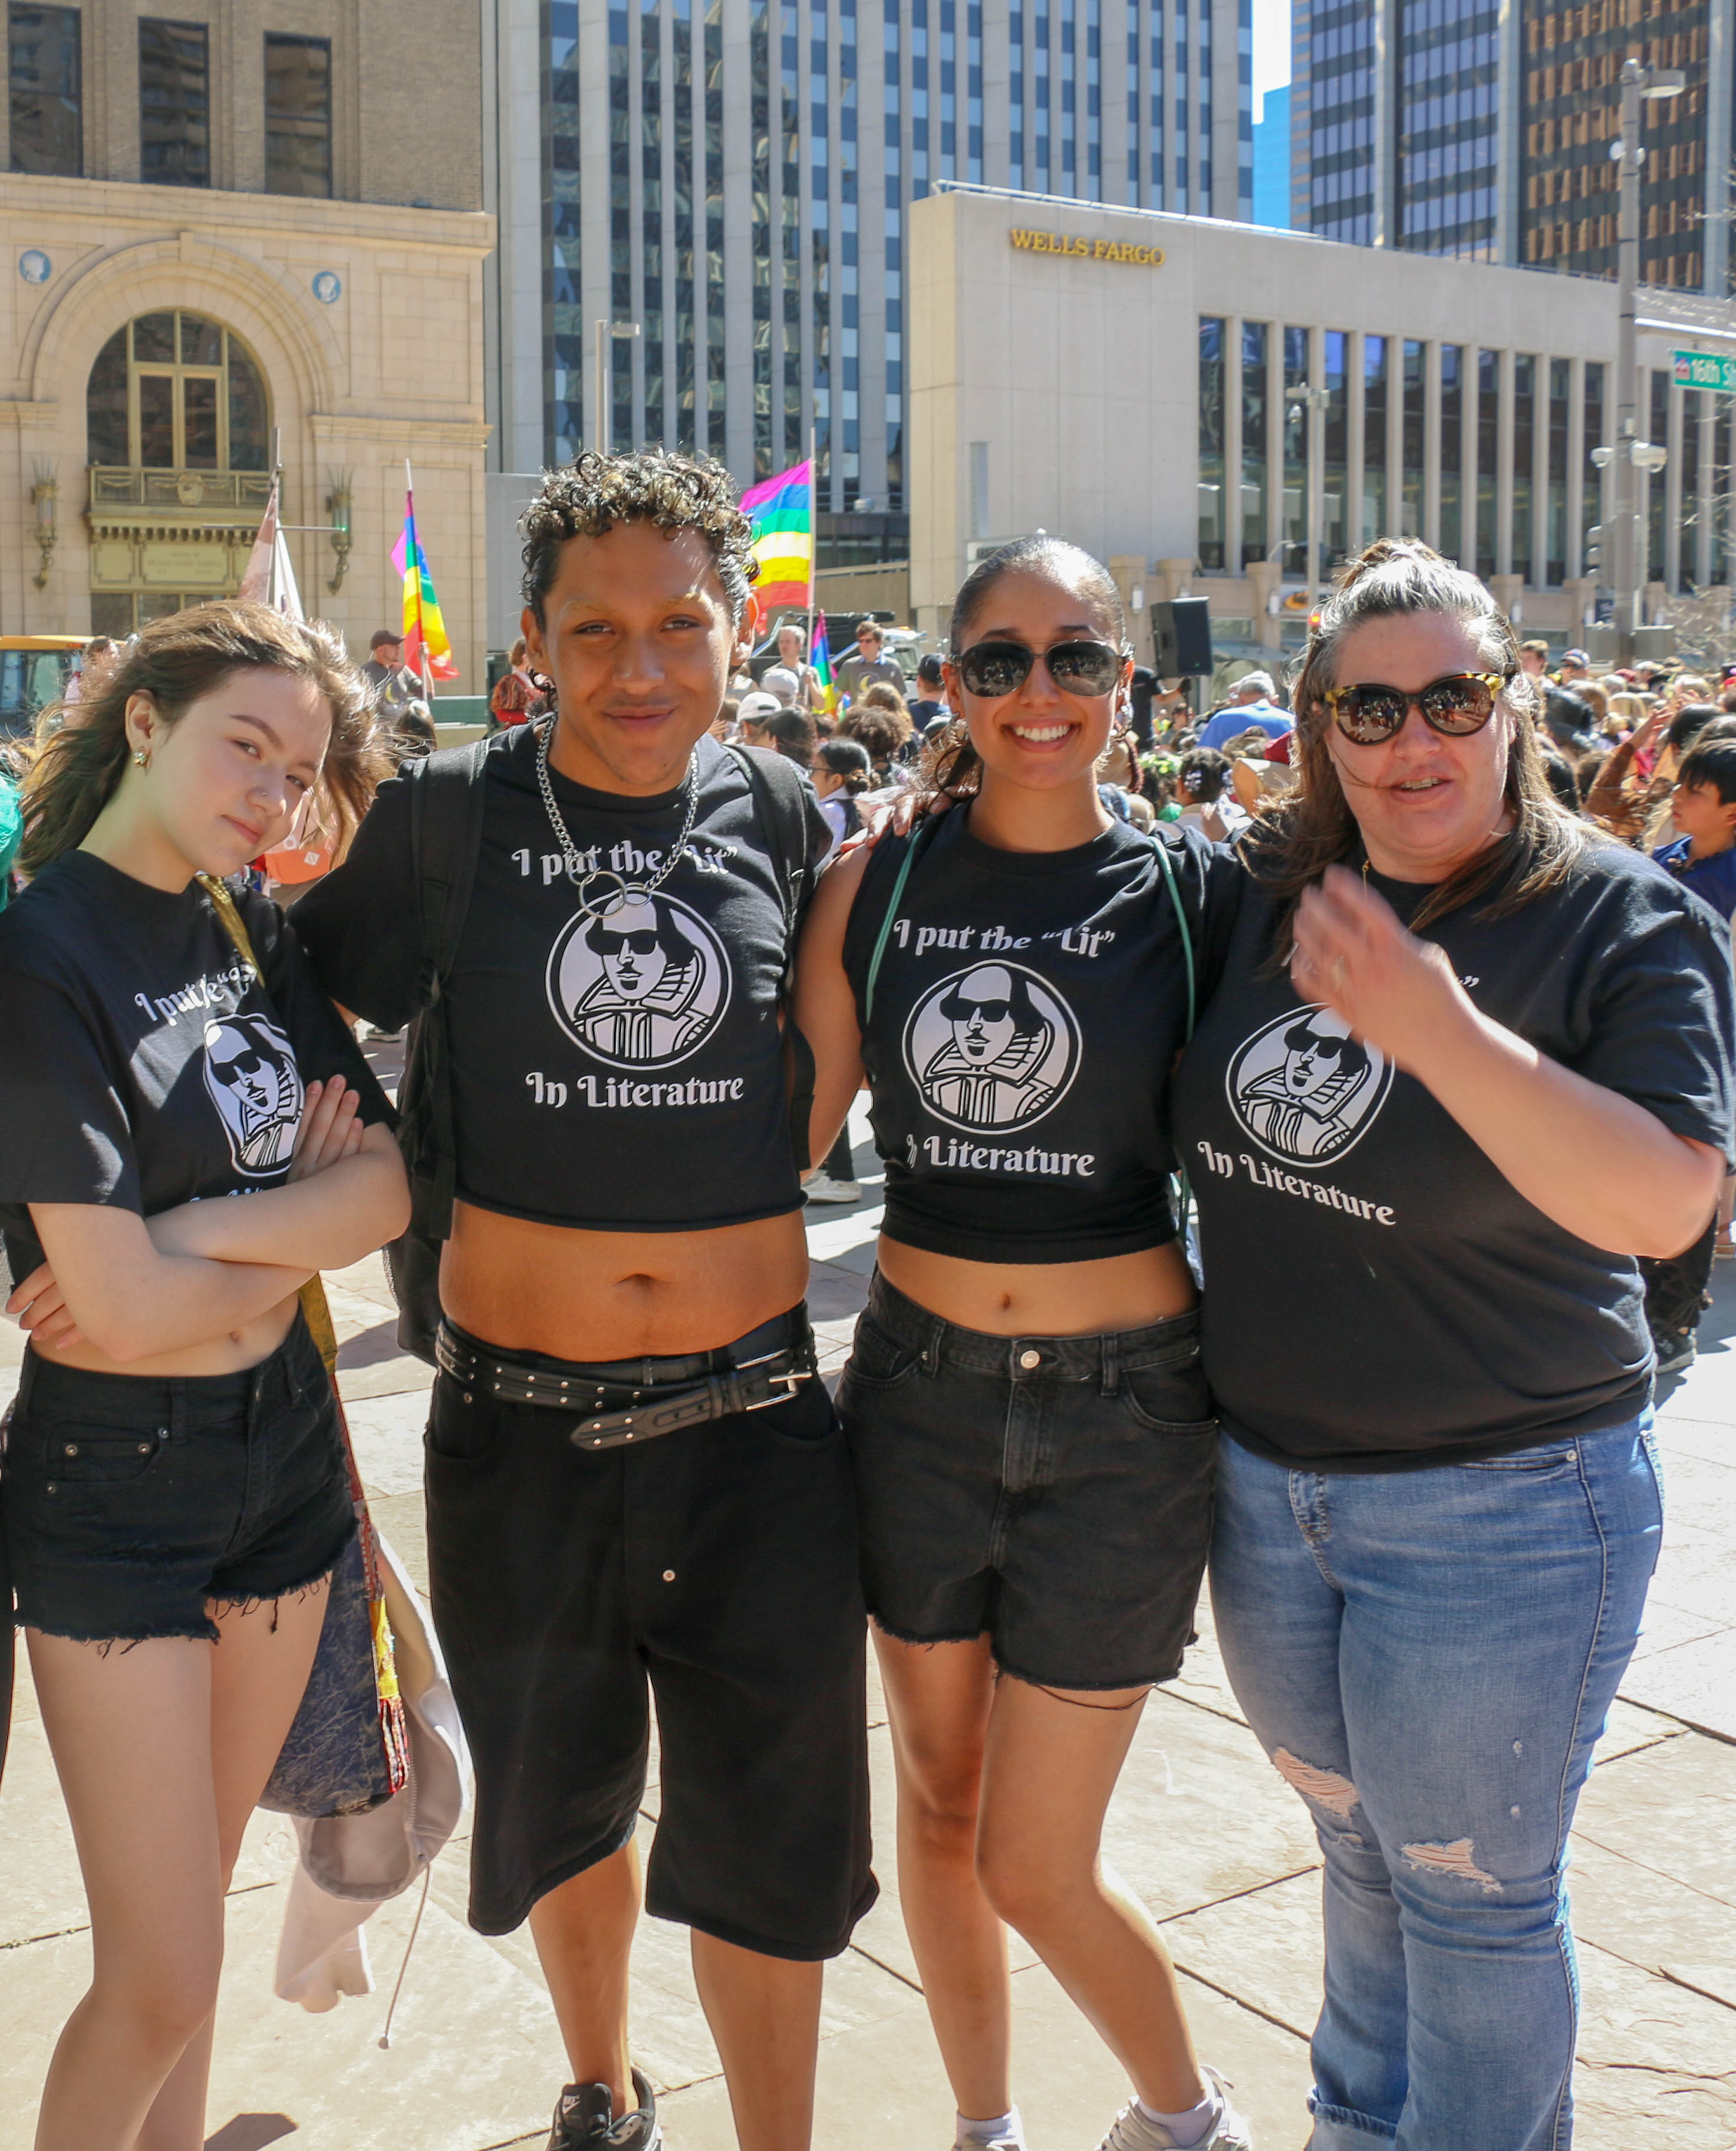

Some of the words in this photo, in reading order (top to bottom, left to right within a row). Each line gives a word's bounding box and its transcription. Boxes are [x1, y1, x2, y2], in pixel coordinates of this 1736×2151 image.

[1011, 228, 1089, 256] WELLS
[1093, 239, 1165, 265] FARGO
[1691, 358, 1721, 383] 16th
[512, 848, 530, 876] I
[540, 844, 602, 884] put
[608, 840, 663, 875] the
[894, 919, 911, 948] I
[915, 926, 975, 955] put
[980, 926, 1032, 950] the
[526, 1072, 568, 1108] In
[577, 1076, 745, 1107] Literature
[923, 1136, 1095, 1176] Literature
[1198, 1141, 1234, 1178] In
[1240, 1154, 1396, 1226] Literature
